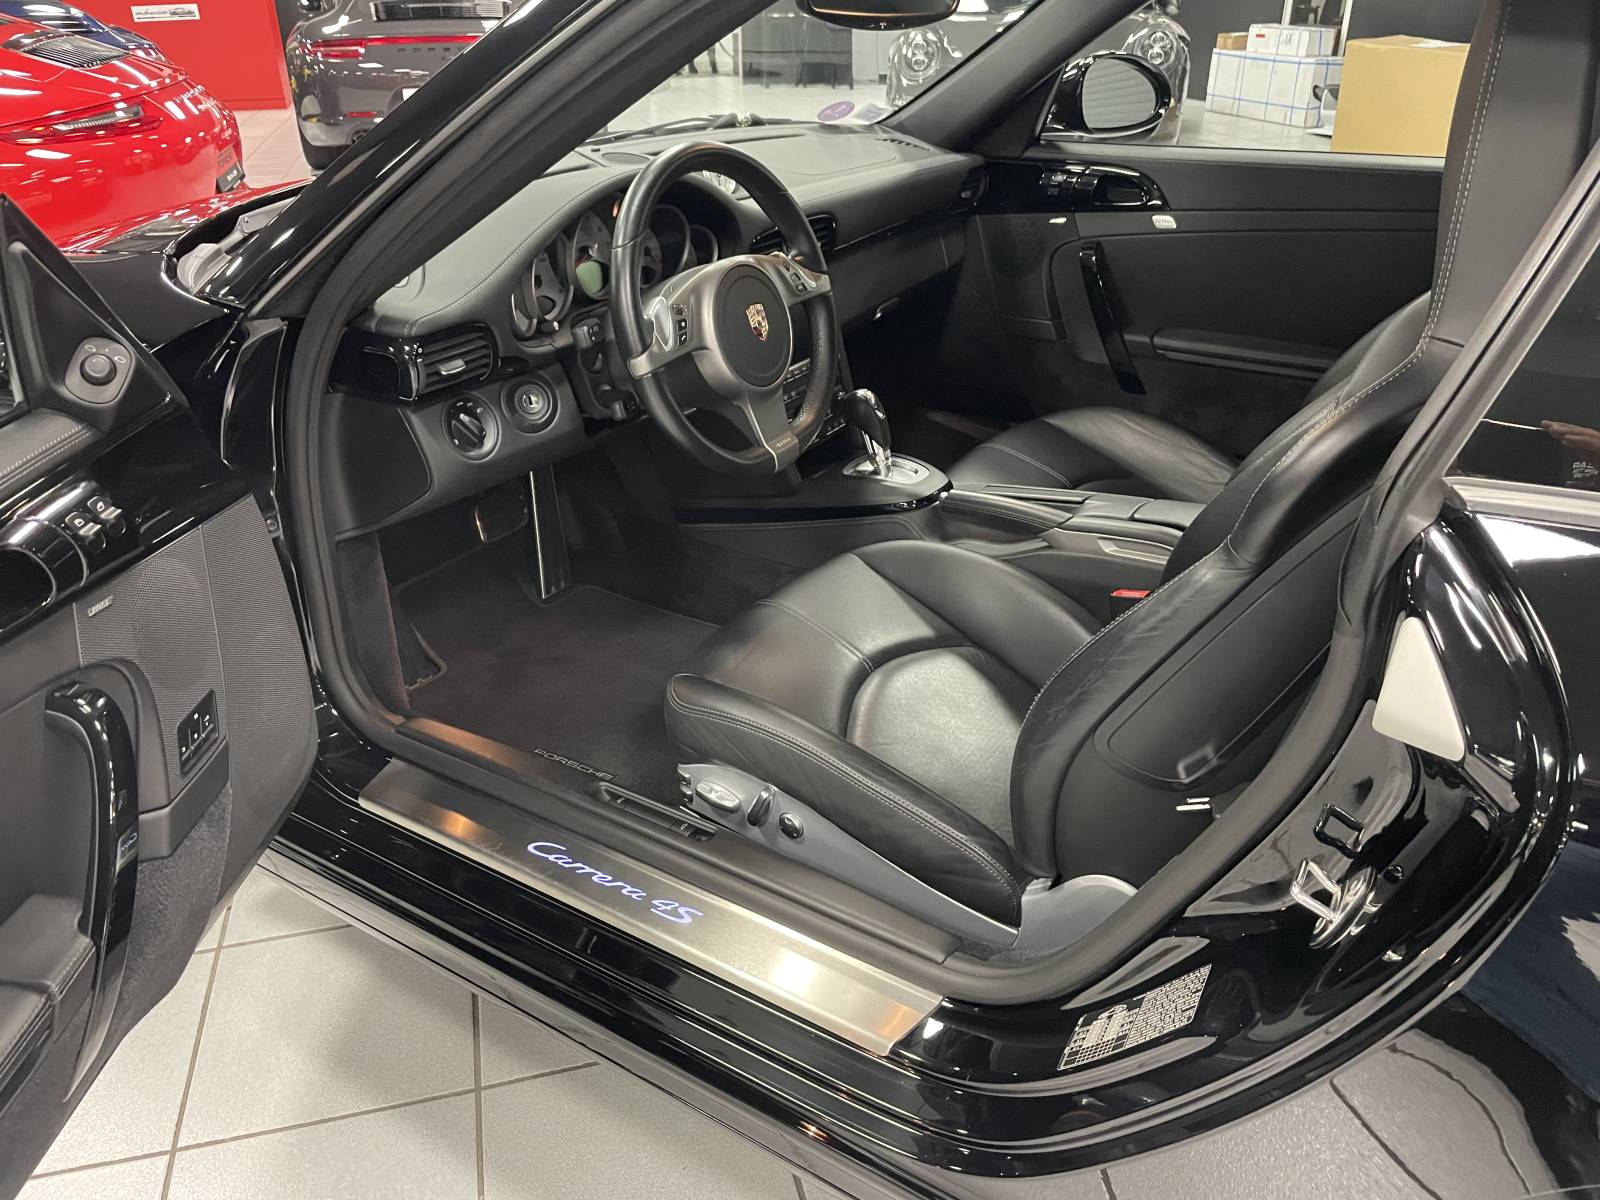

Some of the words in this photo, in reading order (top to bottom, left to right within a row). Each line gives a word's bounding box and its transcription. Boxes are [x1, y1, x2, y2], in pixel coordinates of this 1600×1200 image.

[534, 748, 614, 780] PORSCHE
[527, 841, 647, 901] Carrera
[650, 899, 704, 924] 4S
